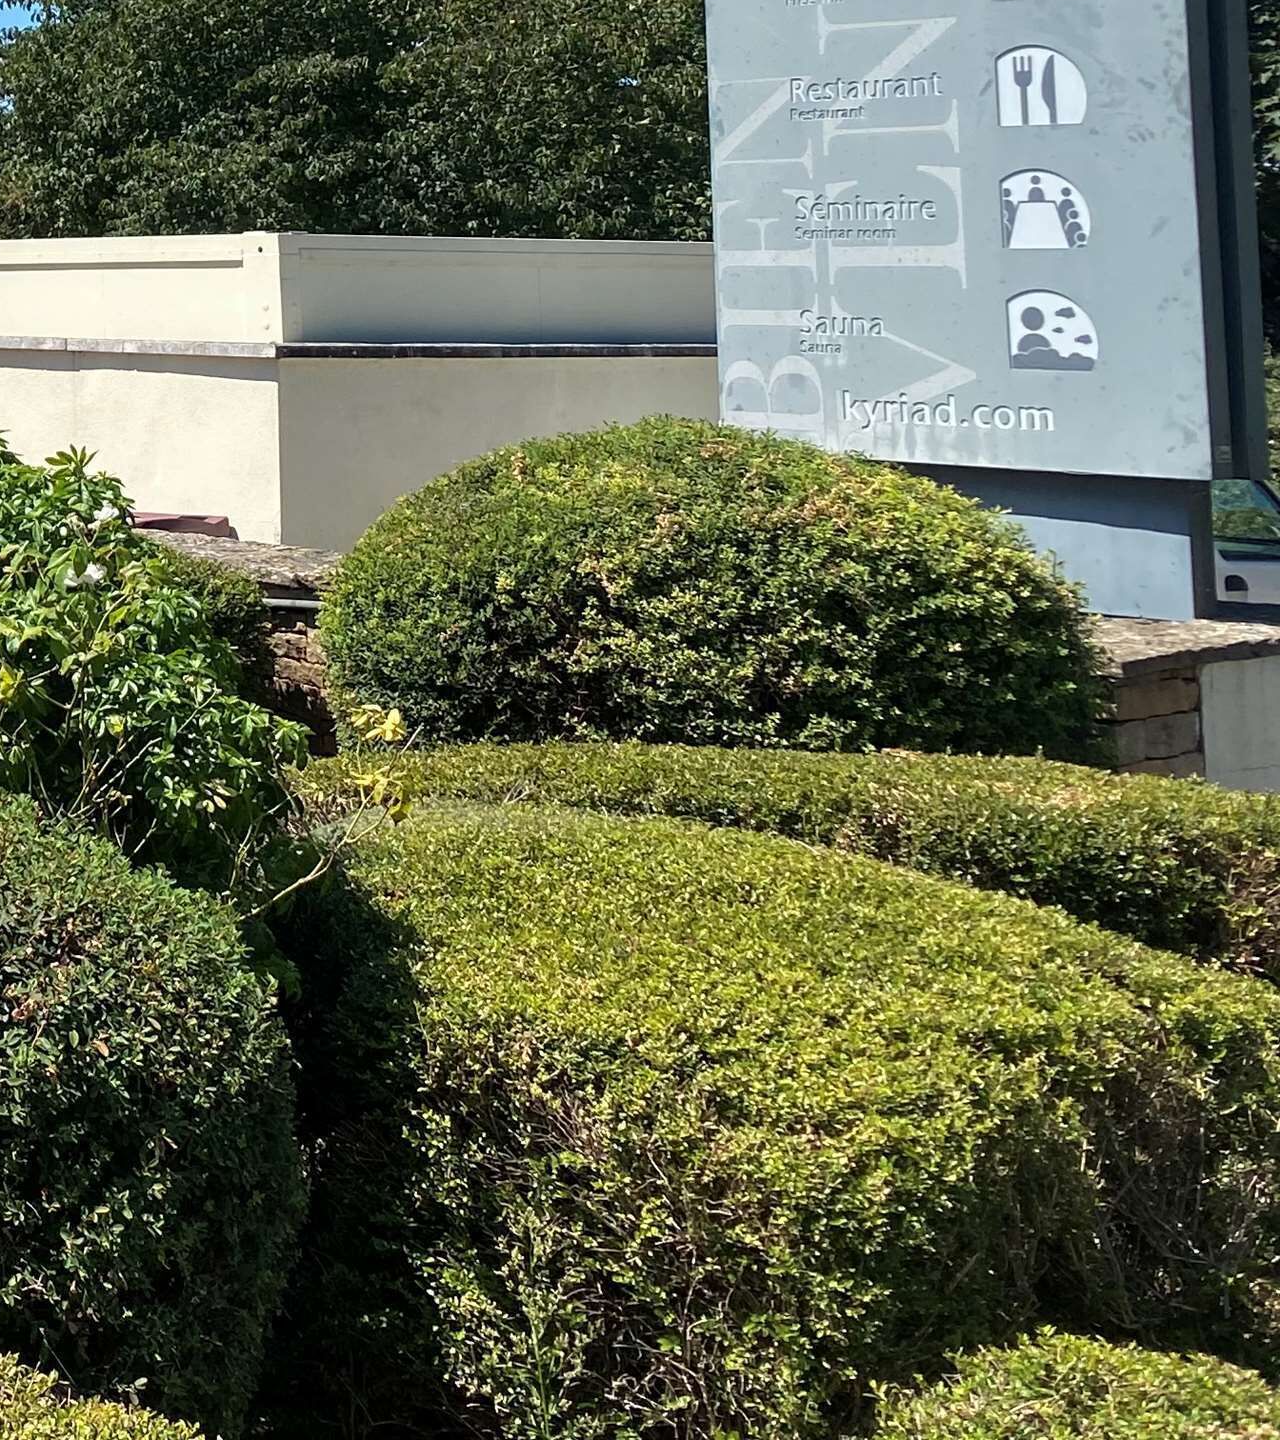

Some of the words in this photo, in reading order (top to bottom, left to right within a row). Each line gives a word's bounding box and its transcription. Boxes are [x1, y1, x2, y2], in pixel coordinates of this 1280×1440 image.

[789, 72, 944, 104] Restaurant
[789, 106, 865, 122] Restaurant
[794, 193, 938, 223] Séminaire
[793, 226, 853, 241] Seminar
[856, 227, 897, 240] room
[799, 309, 886, 337] Sauna
[798, 340, 842, 354] Sauna
[841, 390, 1055, 432] kyriad.com
